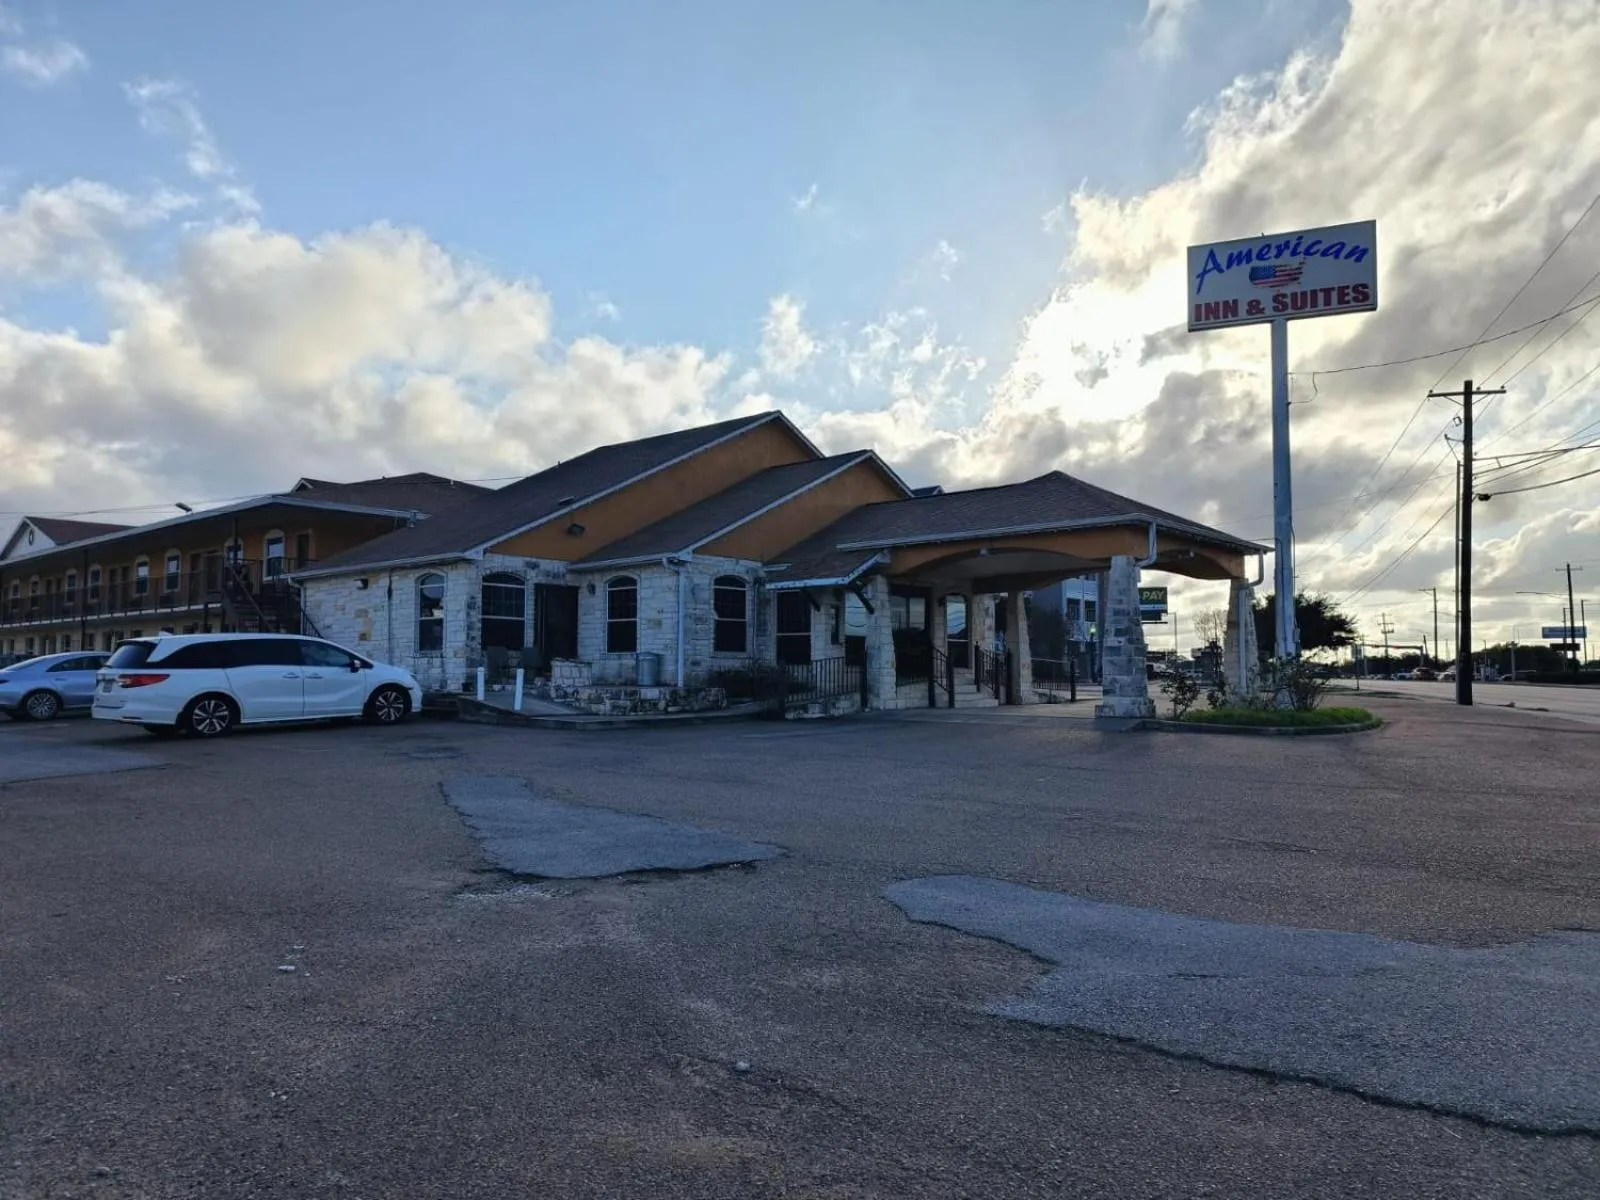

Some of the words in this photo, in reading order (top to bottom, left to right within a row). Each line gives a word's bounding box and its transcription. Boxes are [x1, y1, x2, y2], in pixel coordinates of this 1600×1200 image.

[1196, 236, 1370, 295] American
[1195, 299, 1239, 322] INN
[1246, 299, 1265, 317] &
[1272, 283, 1370, 313] SUITES
[1143, 591, 1164, 600] PAY
